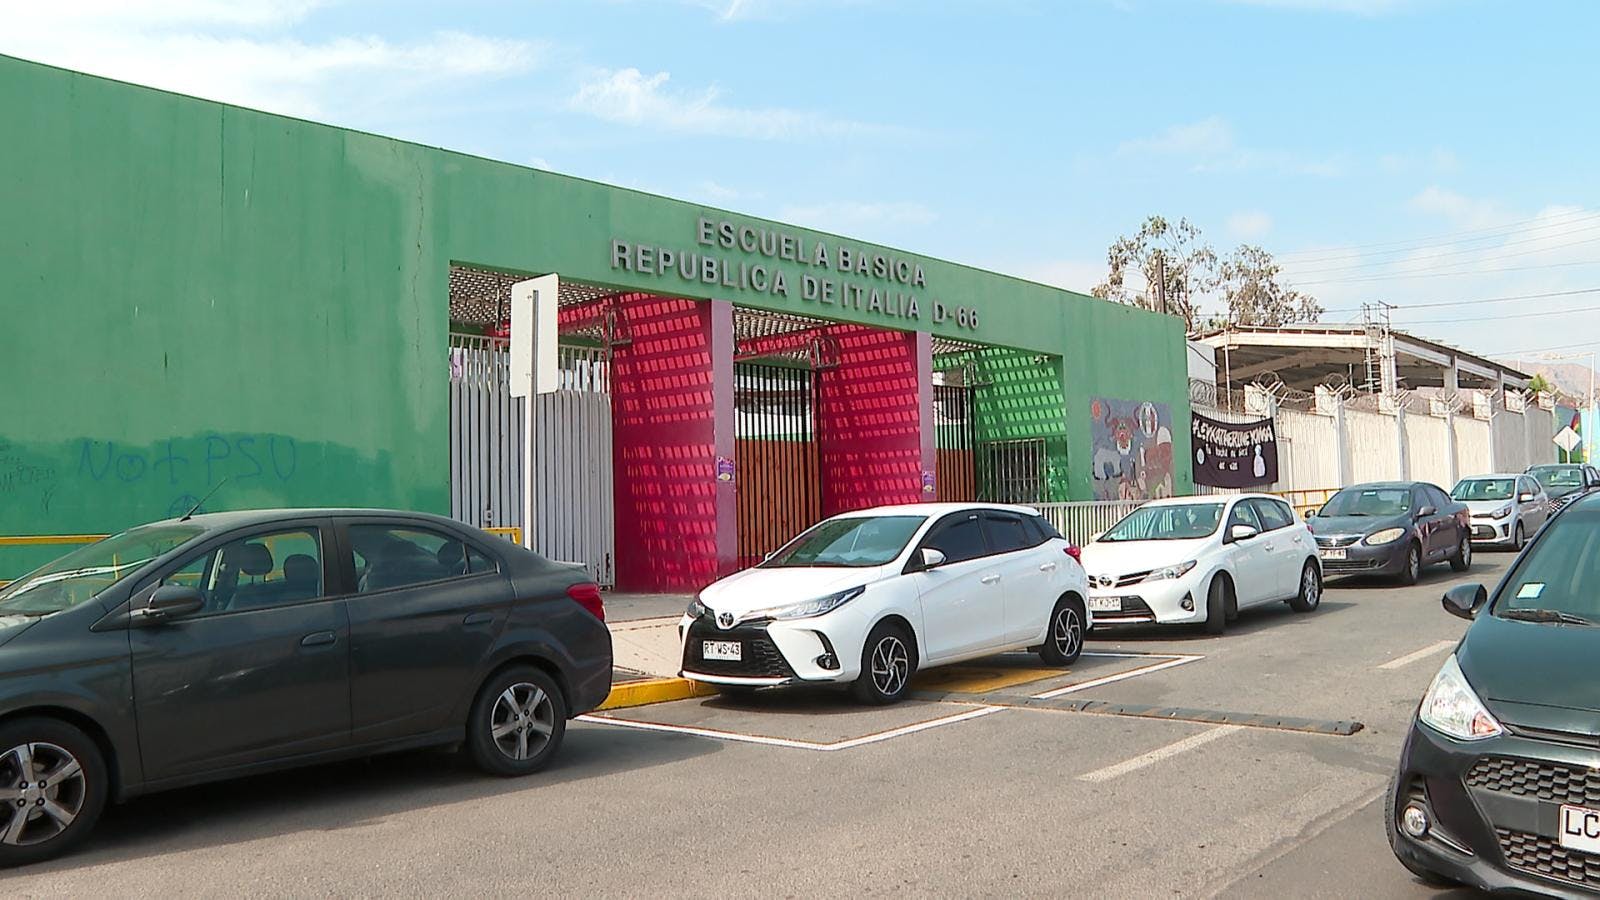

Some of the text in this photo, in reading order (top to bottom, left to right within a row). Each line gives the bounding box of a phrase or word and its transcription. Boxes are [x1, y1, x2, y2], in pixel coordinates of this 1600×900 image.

[697, 215, 926, 288] ESCUELA BASICA
[611, 239, 979, 329] REPUBLICA DE ITALIA D-66
[205, 435, 297, 487] PSU
[1566, 810, 1600, 838] LC
